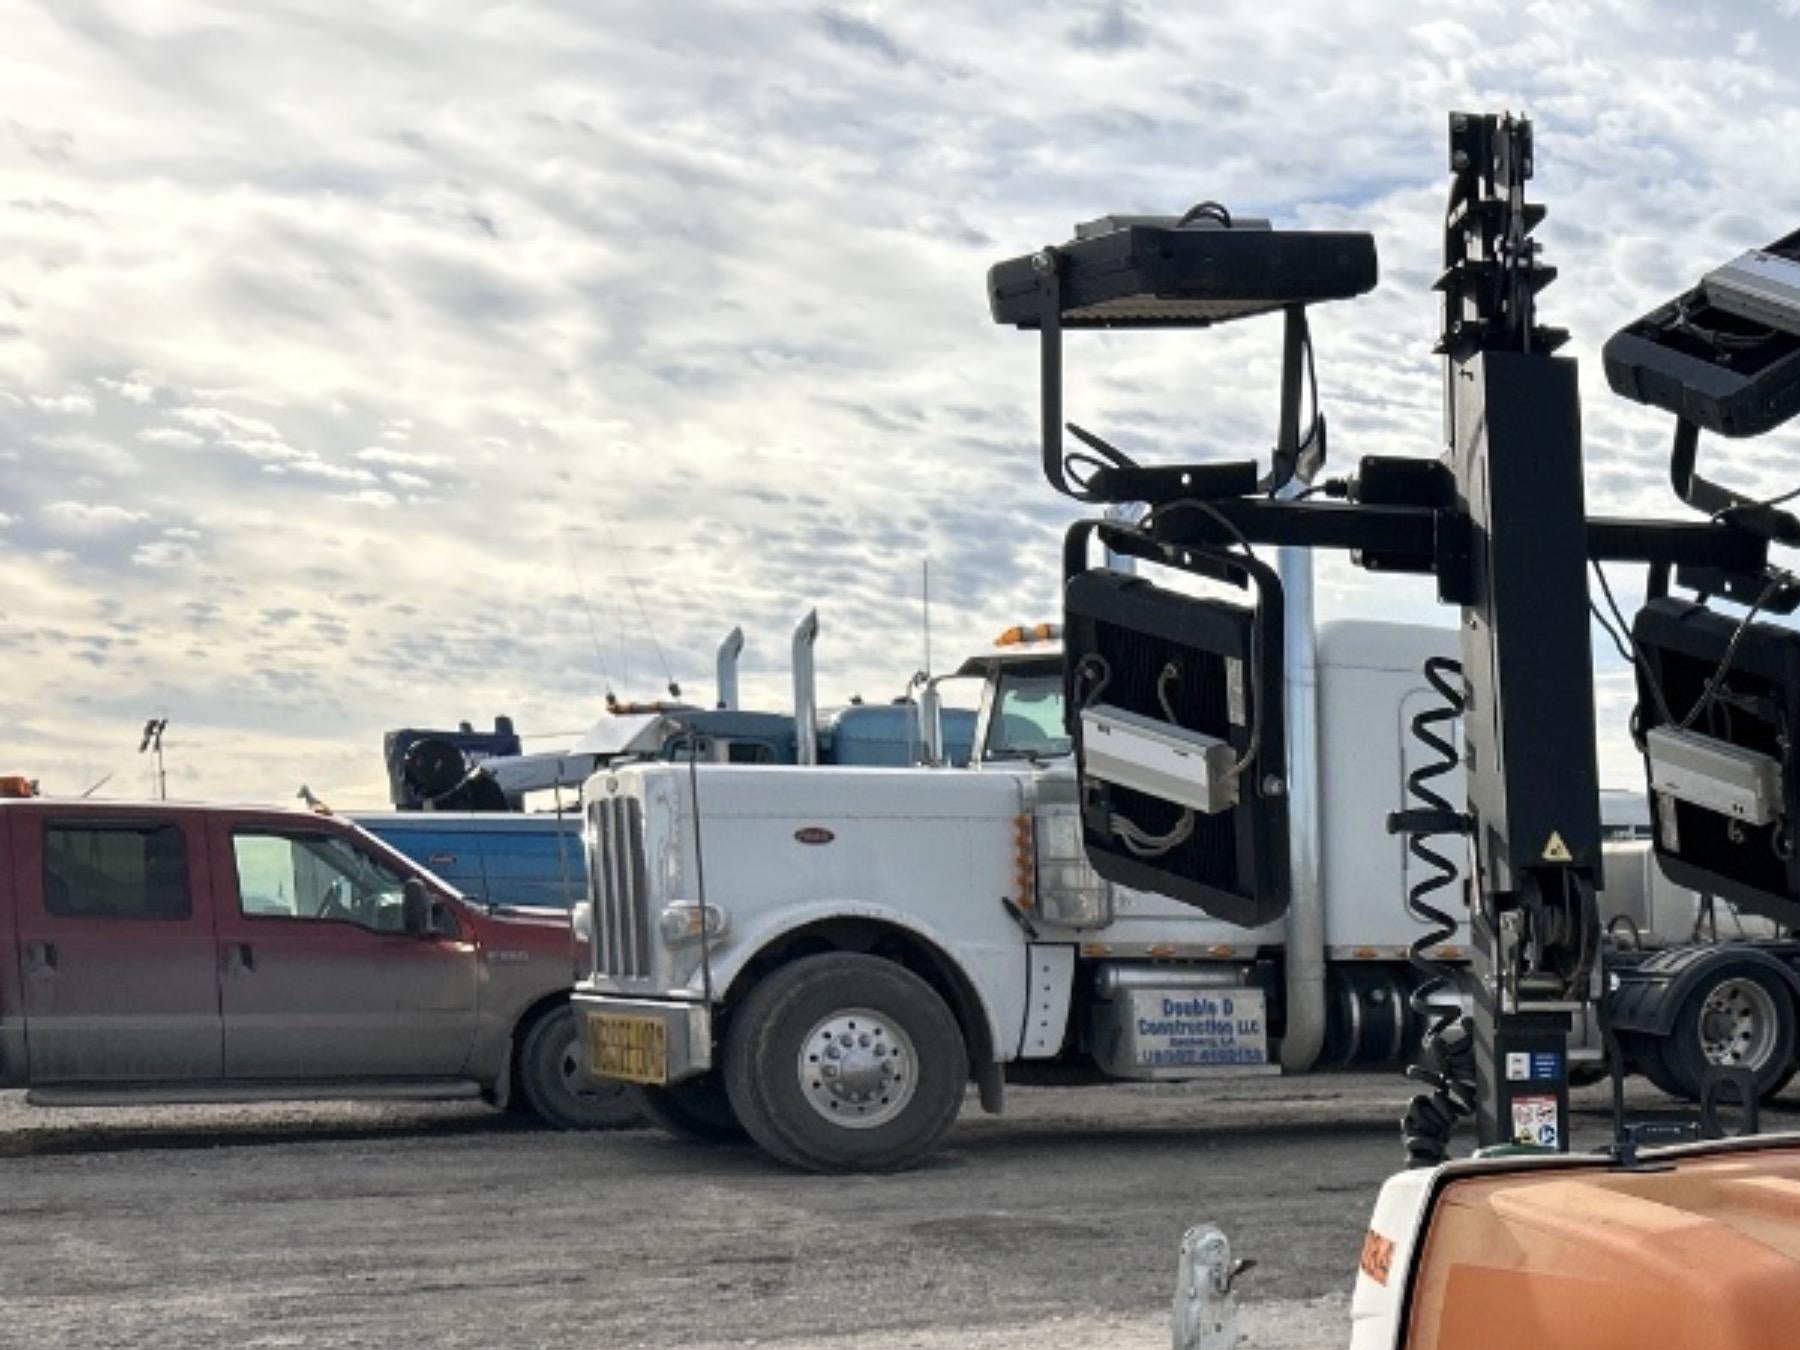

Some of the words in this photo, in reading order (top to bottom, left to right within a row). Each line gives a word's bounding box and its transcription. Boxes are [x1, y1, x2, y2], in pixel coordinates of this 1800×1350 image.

[1163, 998, 1218, 1017] Double
[1138, 1018, 1234, 1037] Construction
[1239, 1019, 1261, 1036] LLC
